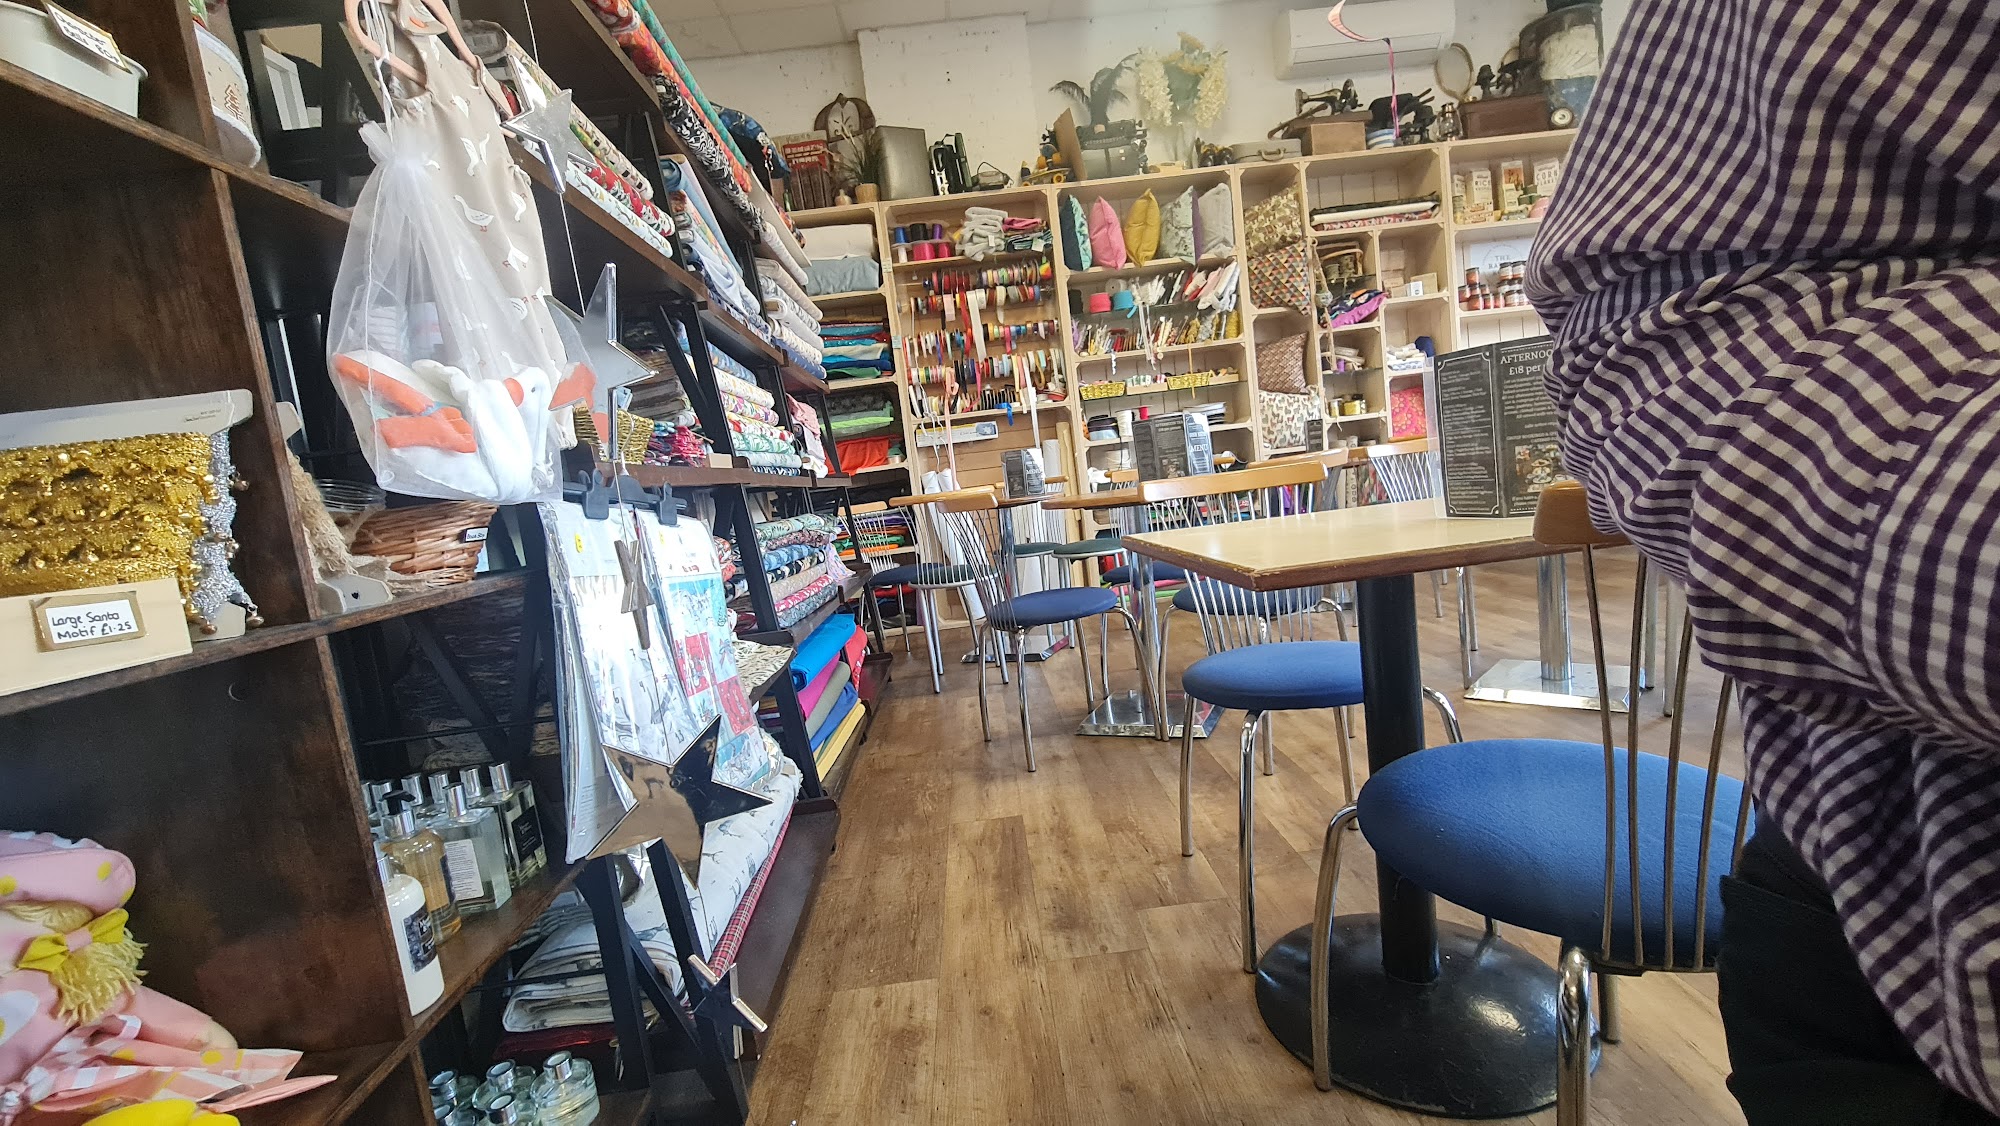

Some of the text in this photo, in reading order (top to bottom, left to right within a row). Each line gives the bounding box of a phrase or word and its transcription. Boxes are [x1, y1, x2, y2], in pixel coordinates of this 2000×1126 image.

[1536, 169, 1558, 181] CORN
[1500, 349, 1554, 365] AFTERNOO
[1509, 364, 1542, 376] £18 per
[1189, 443, 1208, 452] MENU
[51, 611, 119, 628] Large Santa
[57, 621, 132, 640] Motif £1.25
